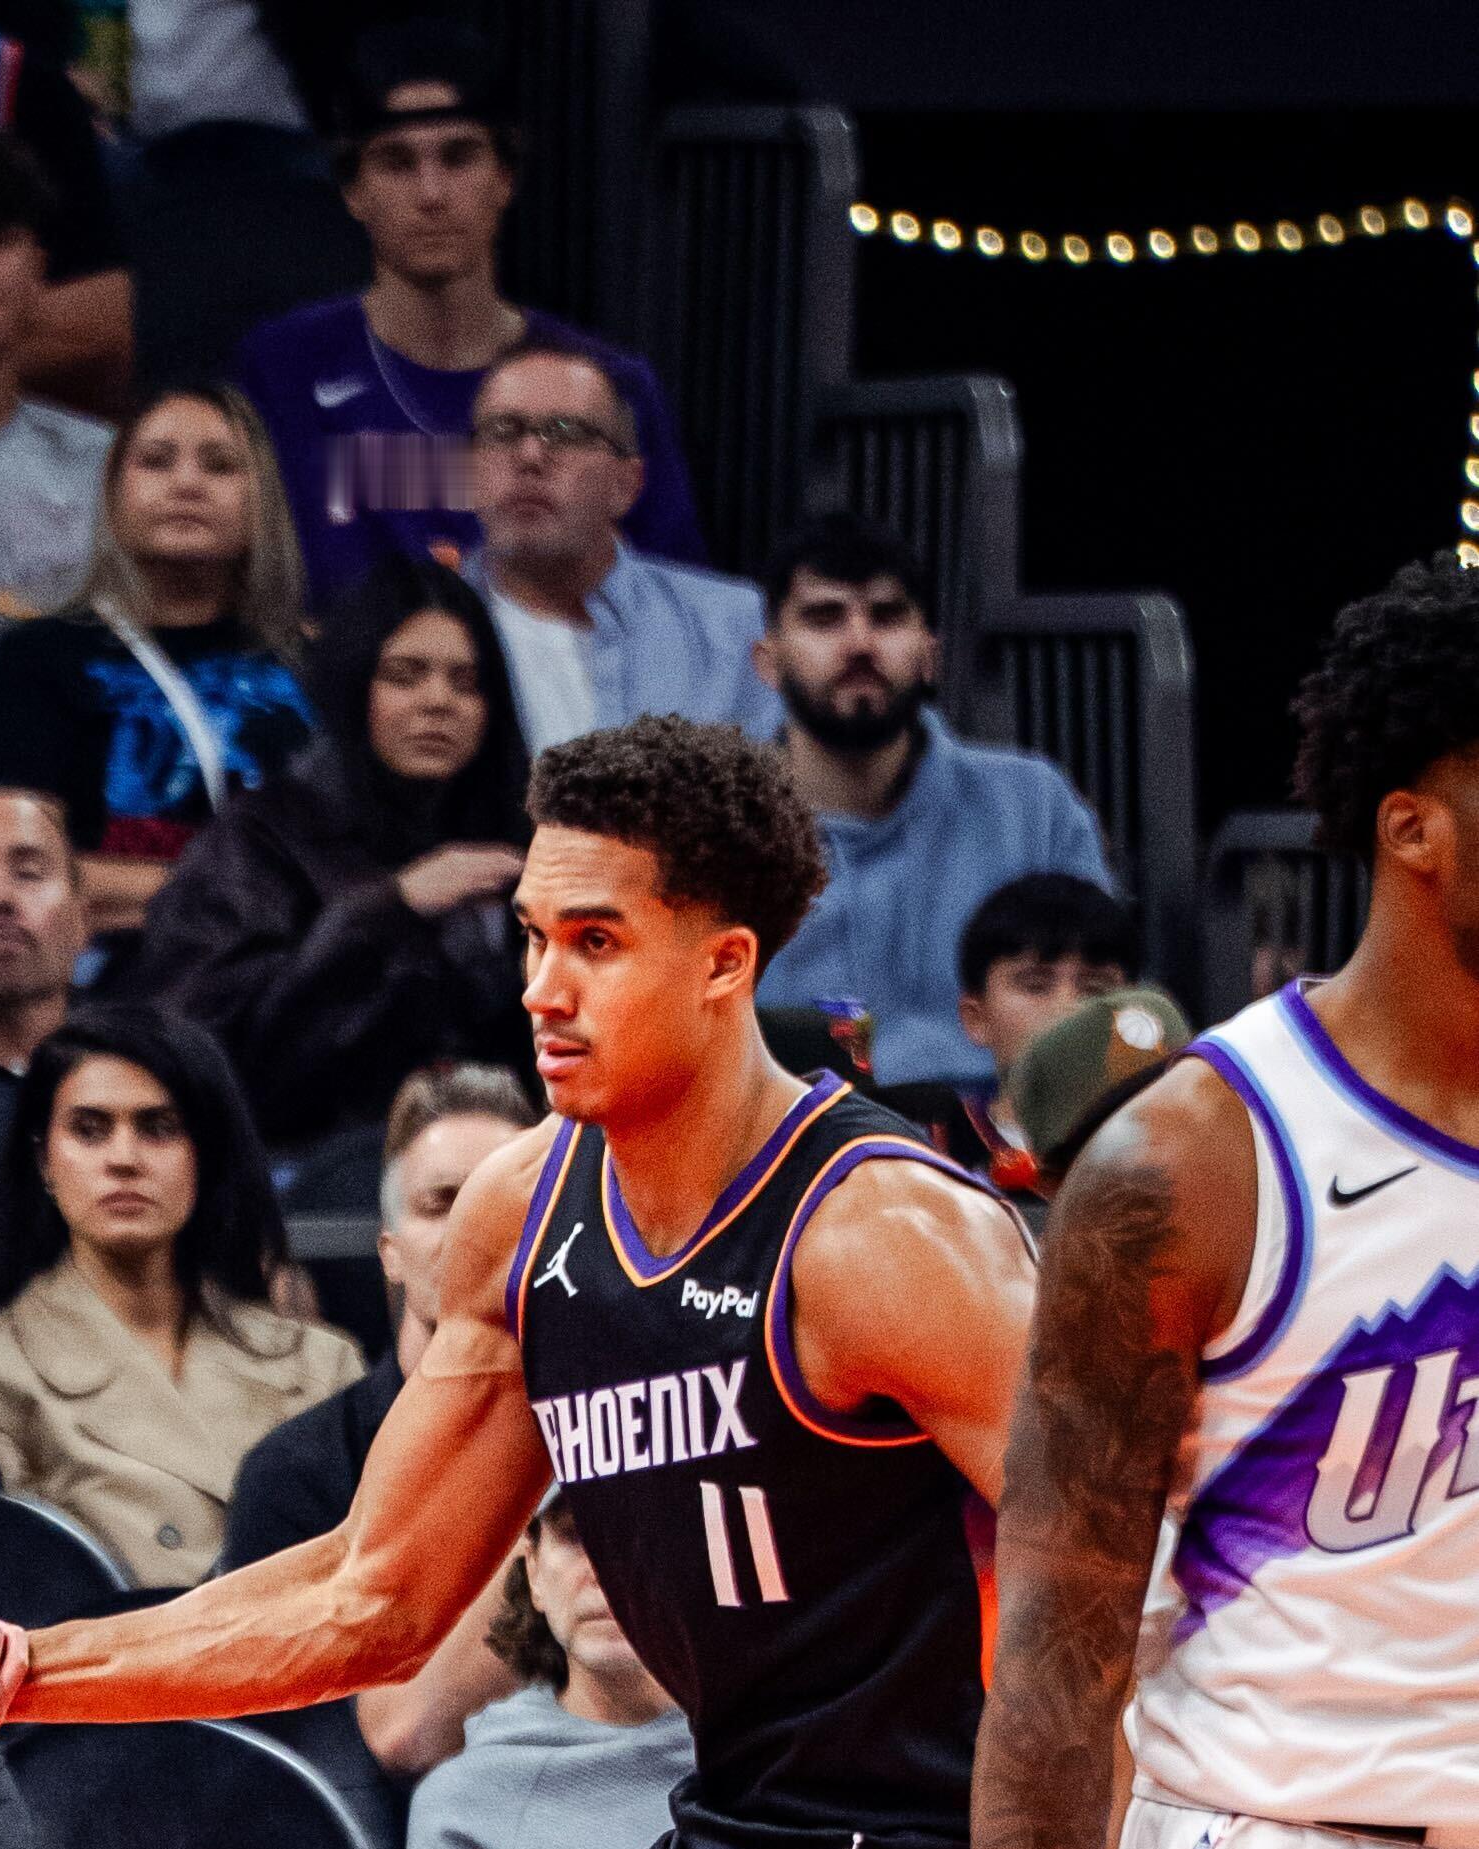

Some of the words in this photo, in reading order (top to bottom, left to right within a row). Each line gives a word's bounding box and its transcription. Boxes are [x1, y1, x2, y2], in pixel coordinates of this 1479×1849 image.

[681, 1278, 760, 1319] PayPal
[531, 1356, 760, 1484] PHOENIX
[699, 1480, 790, 1608] 11
